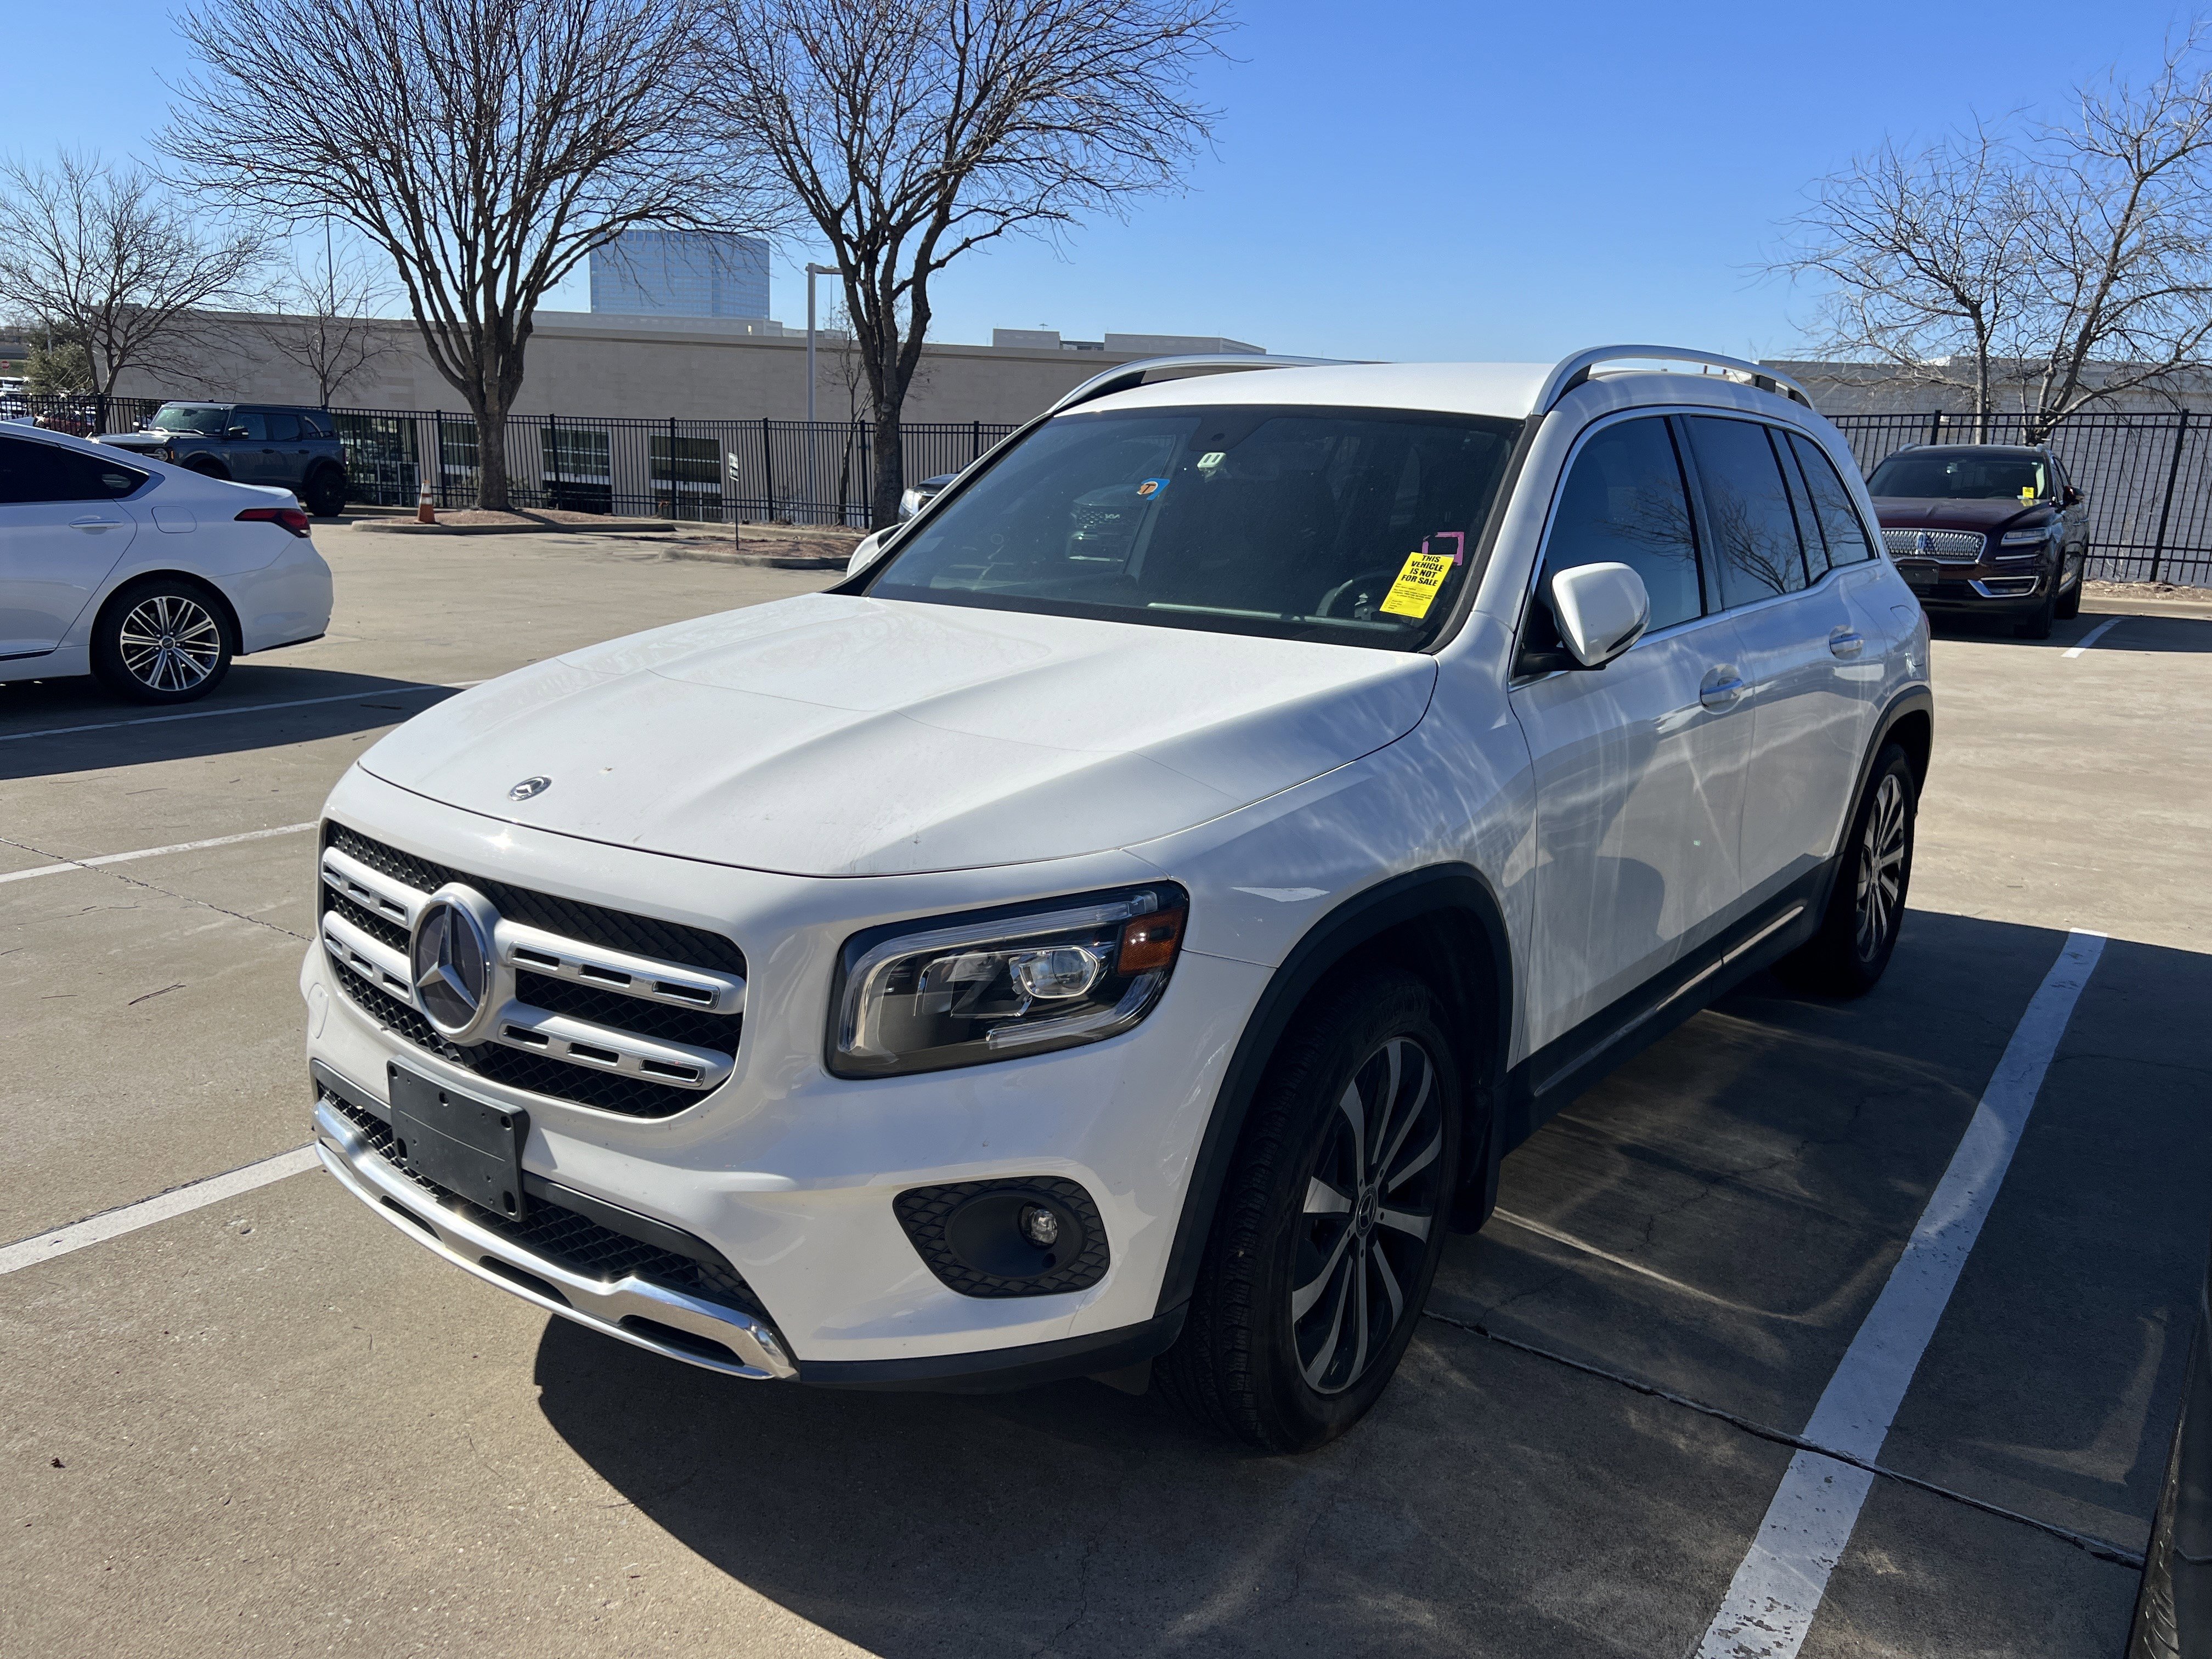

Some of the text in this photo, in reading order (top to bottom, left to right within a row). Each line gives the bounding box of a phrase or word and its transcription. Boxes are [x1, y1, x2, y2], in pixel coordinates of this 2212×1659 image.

[1411, 561, 1444, 572] VEHICLE
[1419, 569, 1437, 578] NOT
[1418, 577, 1438, 586] SALE
